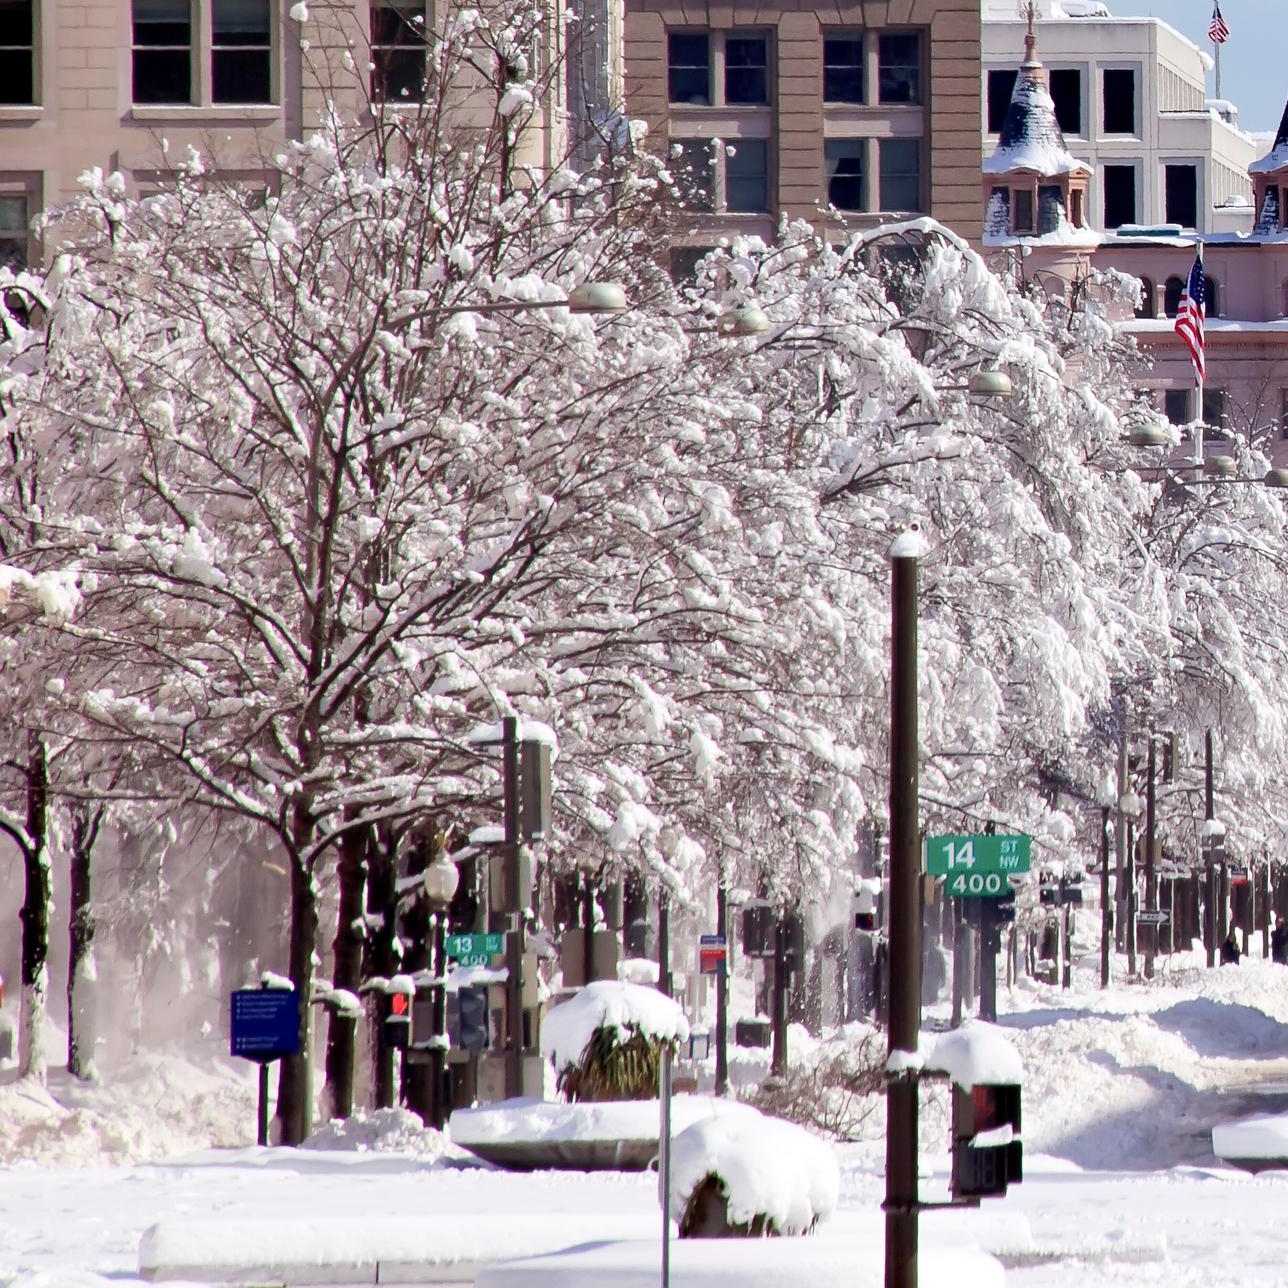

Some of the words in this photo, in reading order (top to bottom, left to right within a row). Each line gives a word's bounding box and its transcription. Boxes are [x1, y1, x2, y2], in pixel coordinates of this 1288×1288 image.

[942, 840, 976, 869] 14
[1001, 840, 1018, 853] ST
[1000, 855, 1020, 868] NW
[952, 873, 1001, 893] 400
[453, 937, 473, 953] 13
[461, 954, 488, 968] 400
